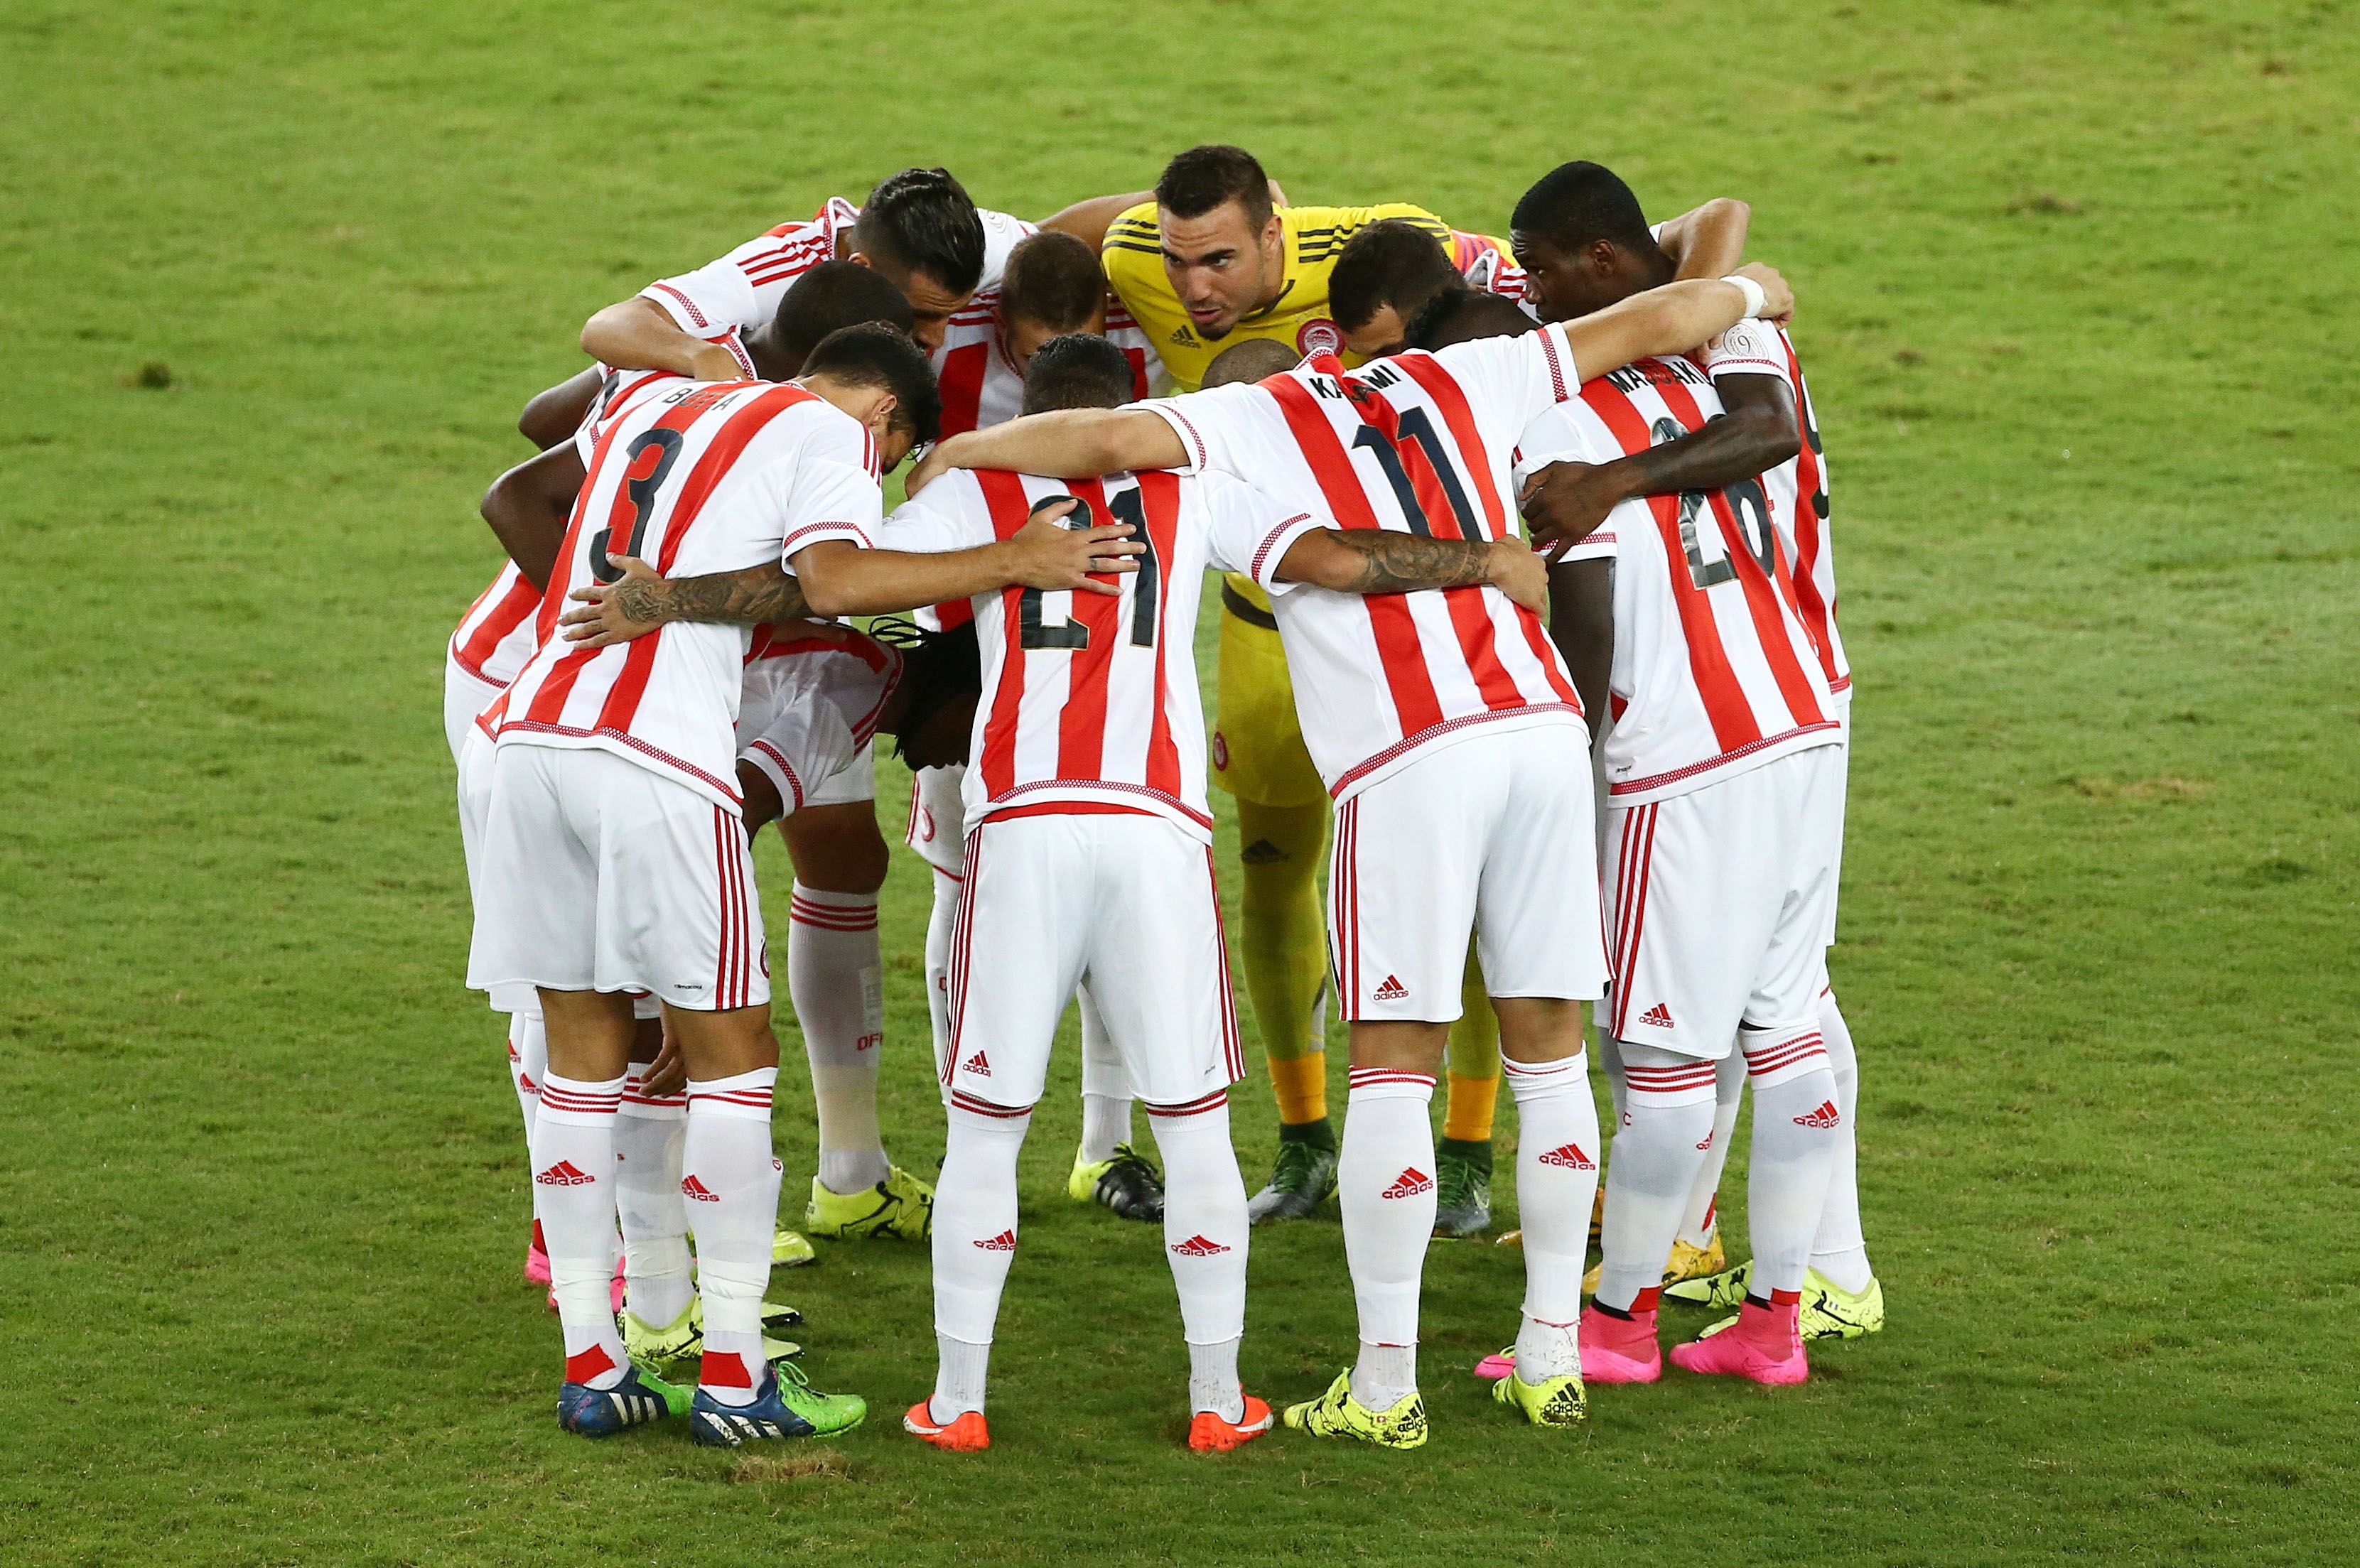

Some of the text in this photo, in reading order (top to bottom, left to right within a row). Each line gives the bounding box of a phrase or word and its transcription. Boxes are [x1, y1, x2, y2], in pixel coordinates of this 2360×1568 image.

[1352, 406, 1484, 542] 11
[588, 428, 684, 583] 3
[1020, 486, 1158, 651] 21
[1373, 989, 1409, 1001] adidas
[1639, 1016, 1675, 1029] adidas
[962, 1064, 991, 1077] adidas
[1539, 1155, 1596, 1171] adidas
[536, 1175, 596, 1186] adidas
[1382, 1179, 1433, 1199] adidas
[1171, 1244, 1231, 1256] adidas
